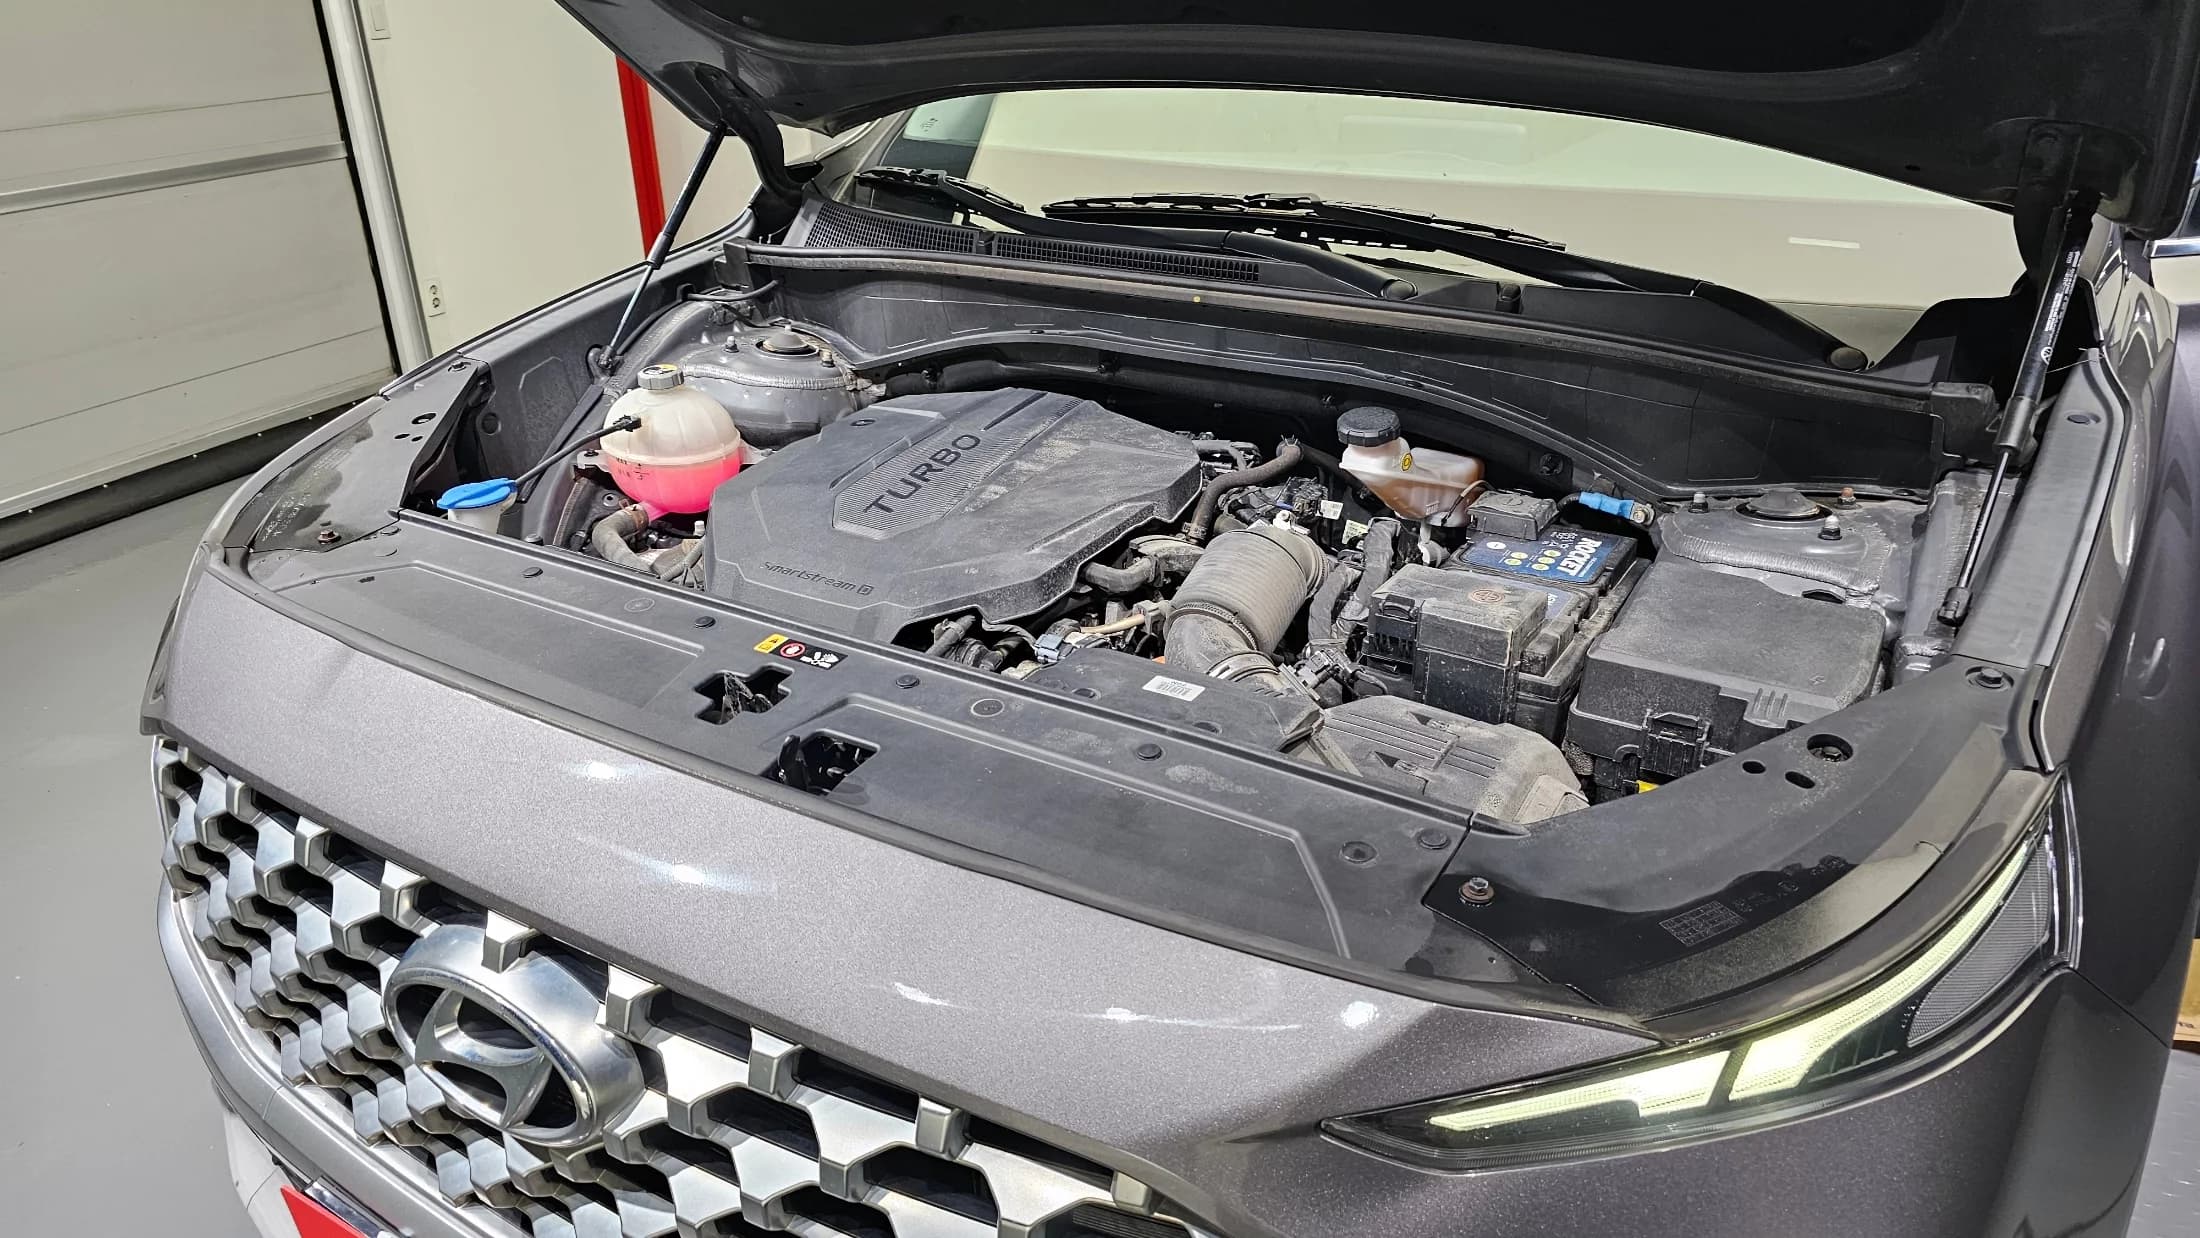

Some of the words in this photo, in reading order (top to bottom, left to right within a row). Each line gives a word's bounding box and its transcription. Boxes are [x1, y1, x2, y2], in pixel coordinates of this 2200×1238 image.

[863, 434, 981, 514] TURBO
[764, 561, 857, 591] smartstream
[1556, 537, 1603, 577] ROCKET
